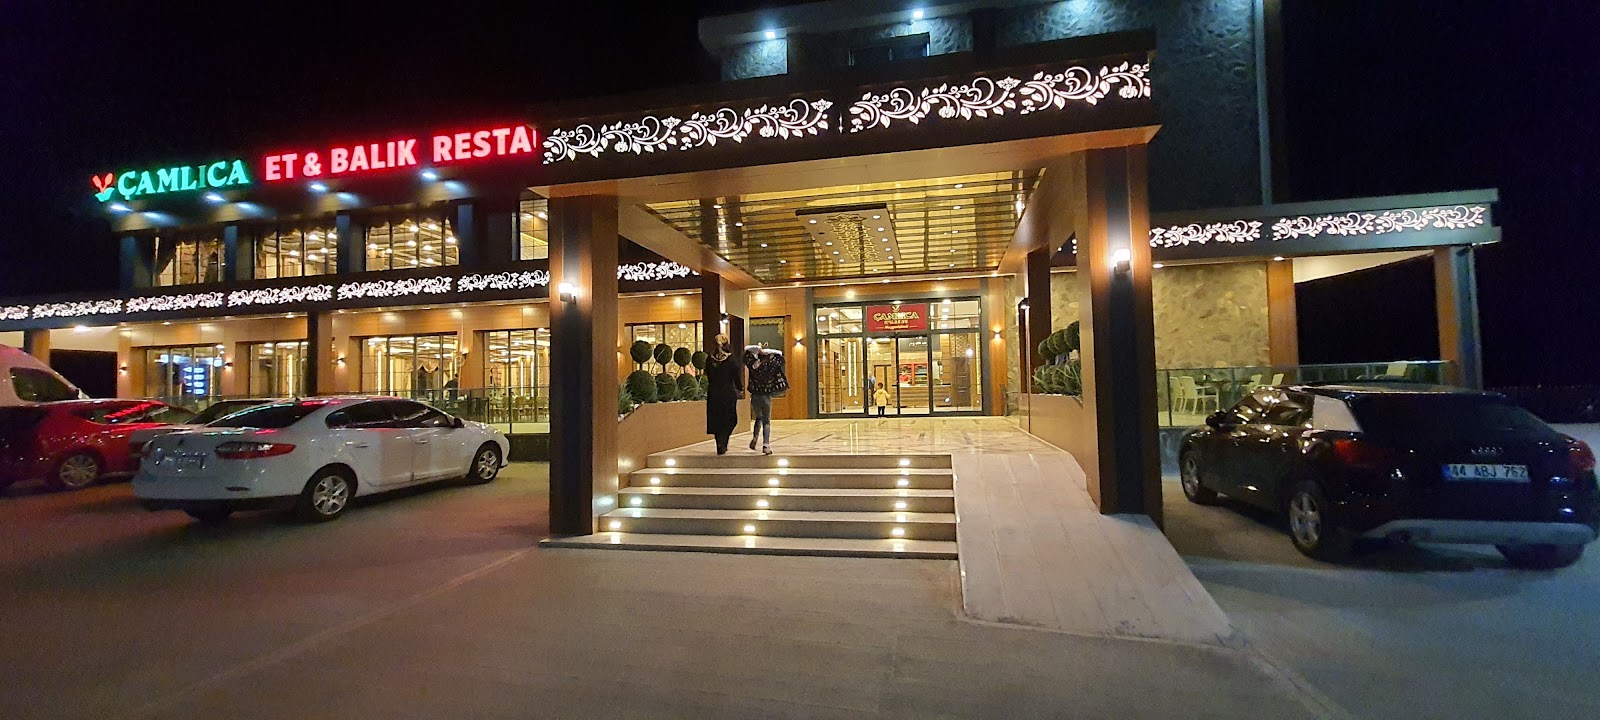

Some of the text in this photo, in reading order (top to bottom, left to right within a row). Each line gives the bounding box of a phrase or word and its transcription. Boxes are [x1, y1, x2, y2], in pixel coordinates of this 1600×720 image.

[117, 125, 537, 200] ÇAMLICA ET & BALIK RESTA
